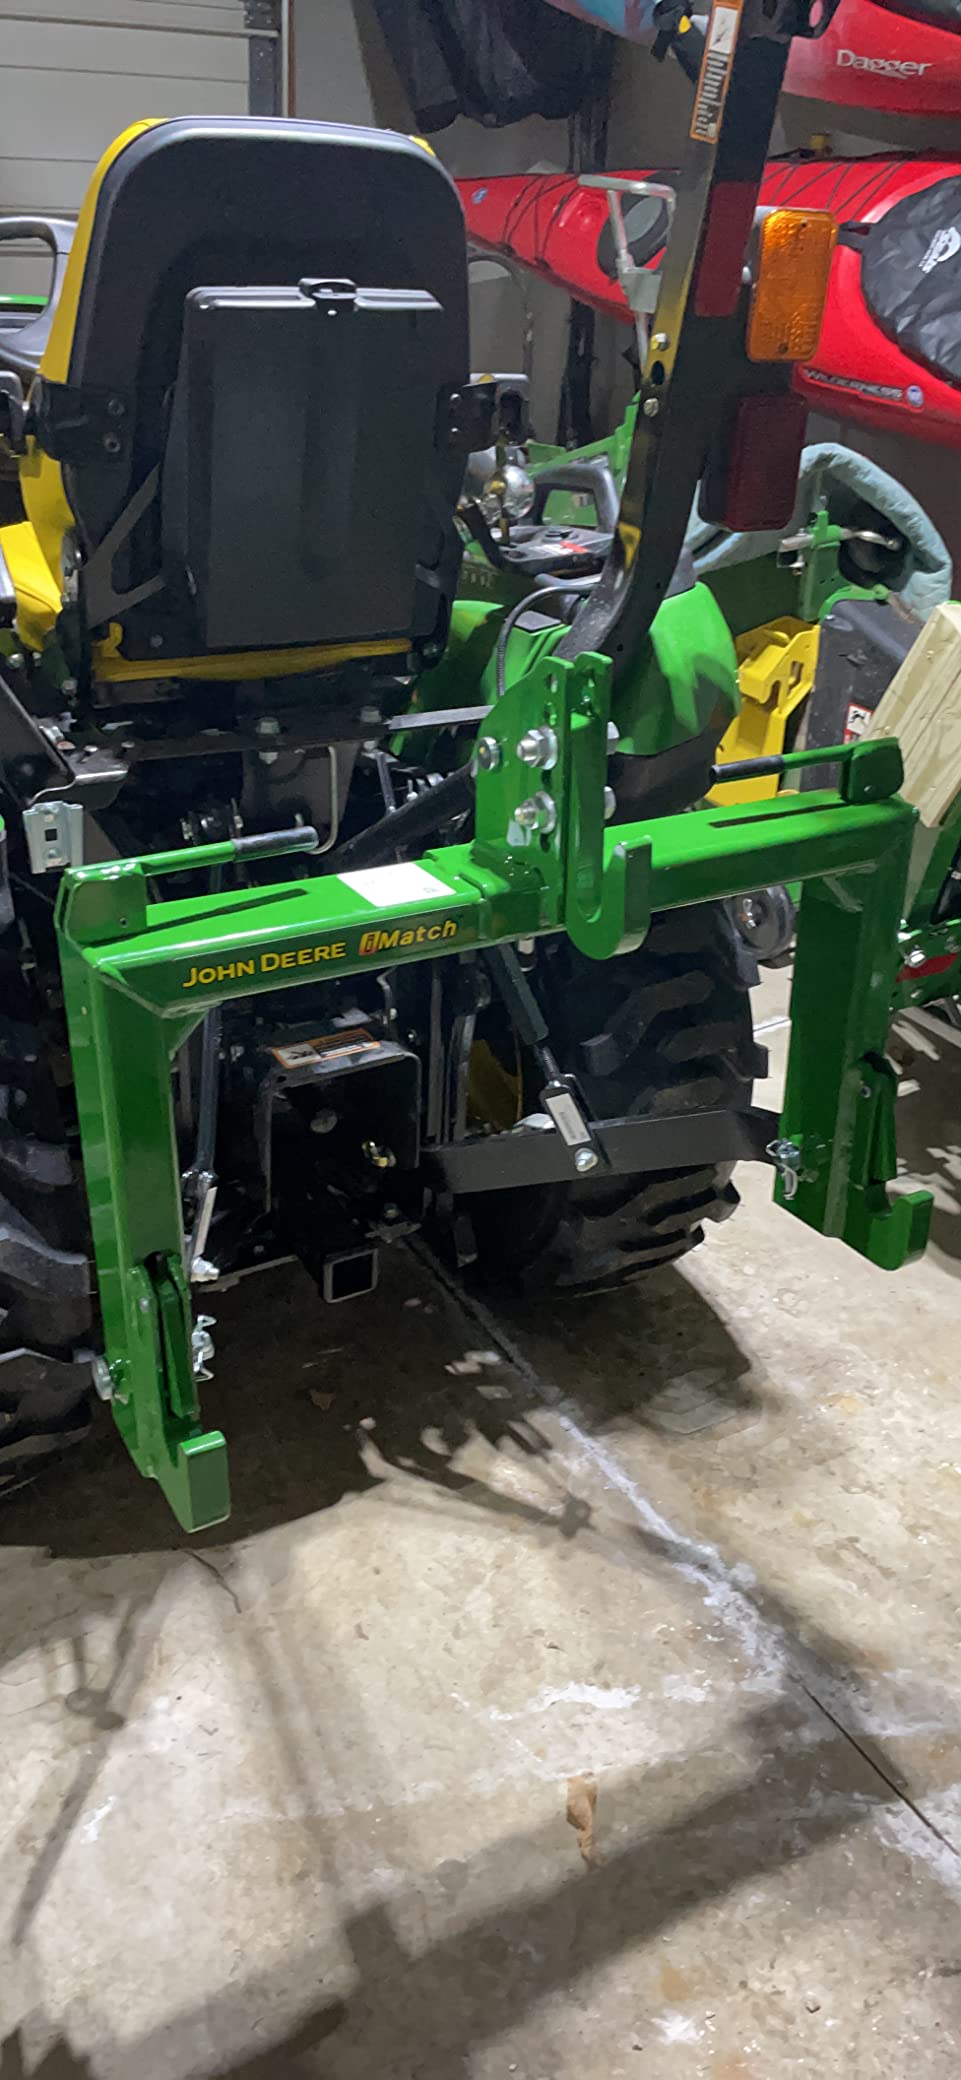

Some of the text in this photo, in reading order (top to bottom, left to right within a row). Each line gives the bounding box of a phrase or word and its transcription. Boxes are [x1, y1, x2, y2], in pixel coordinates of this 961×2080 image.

[836, 49, 933, 79] Dagger
[183, 920, 457, 988] JOHN DEERE iMatch
